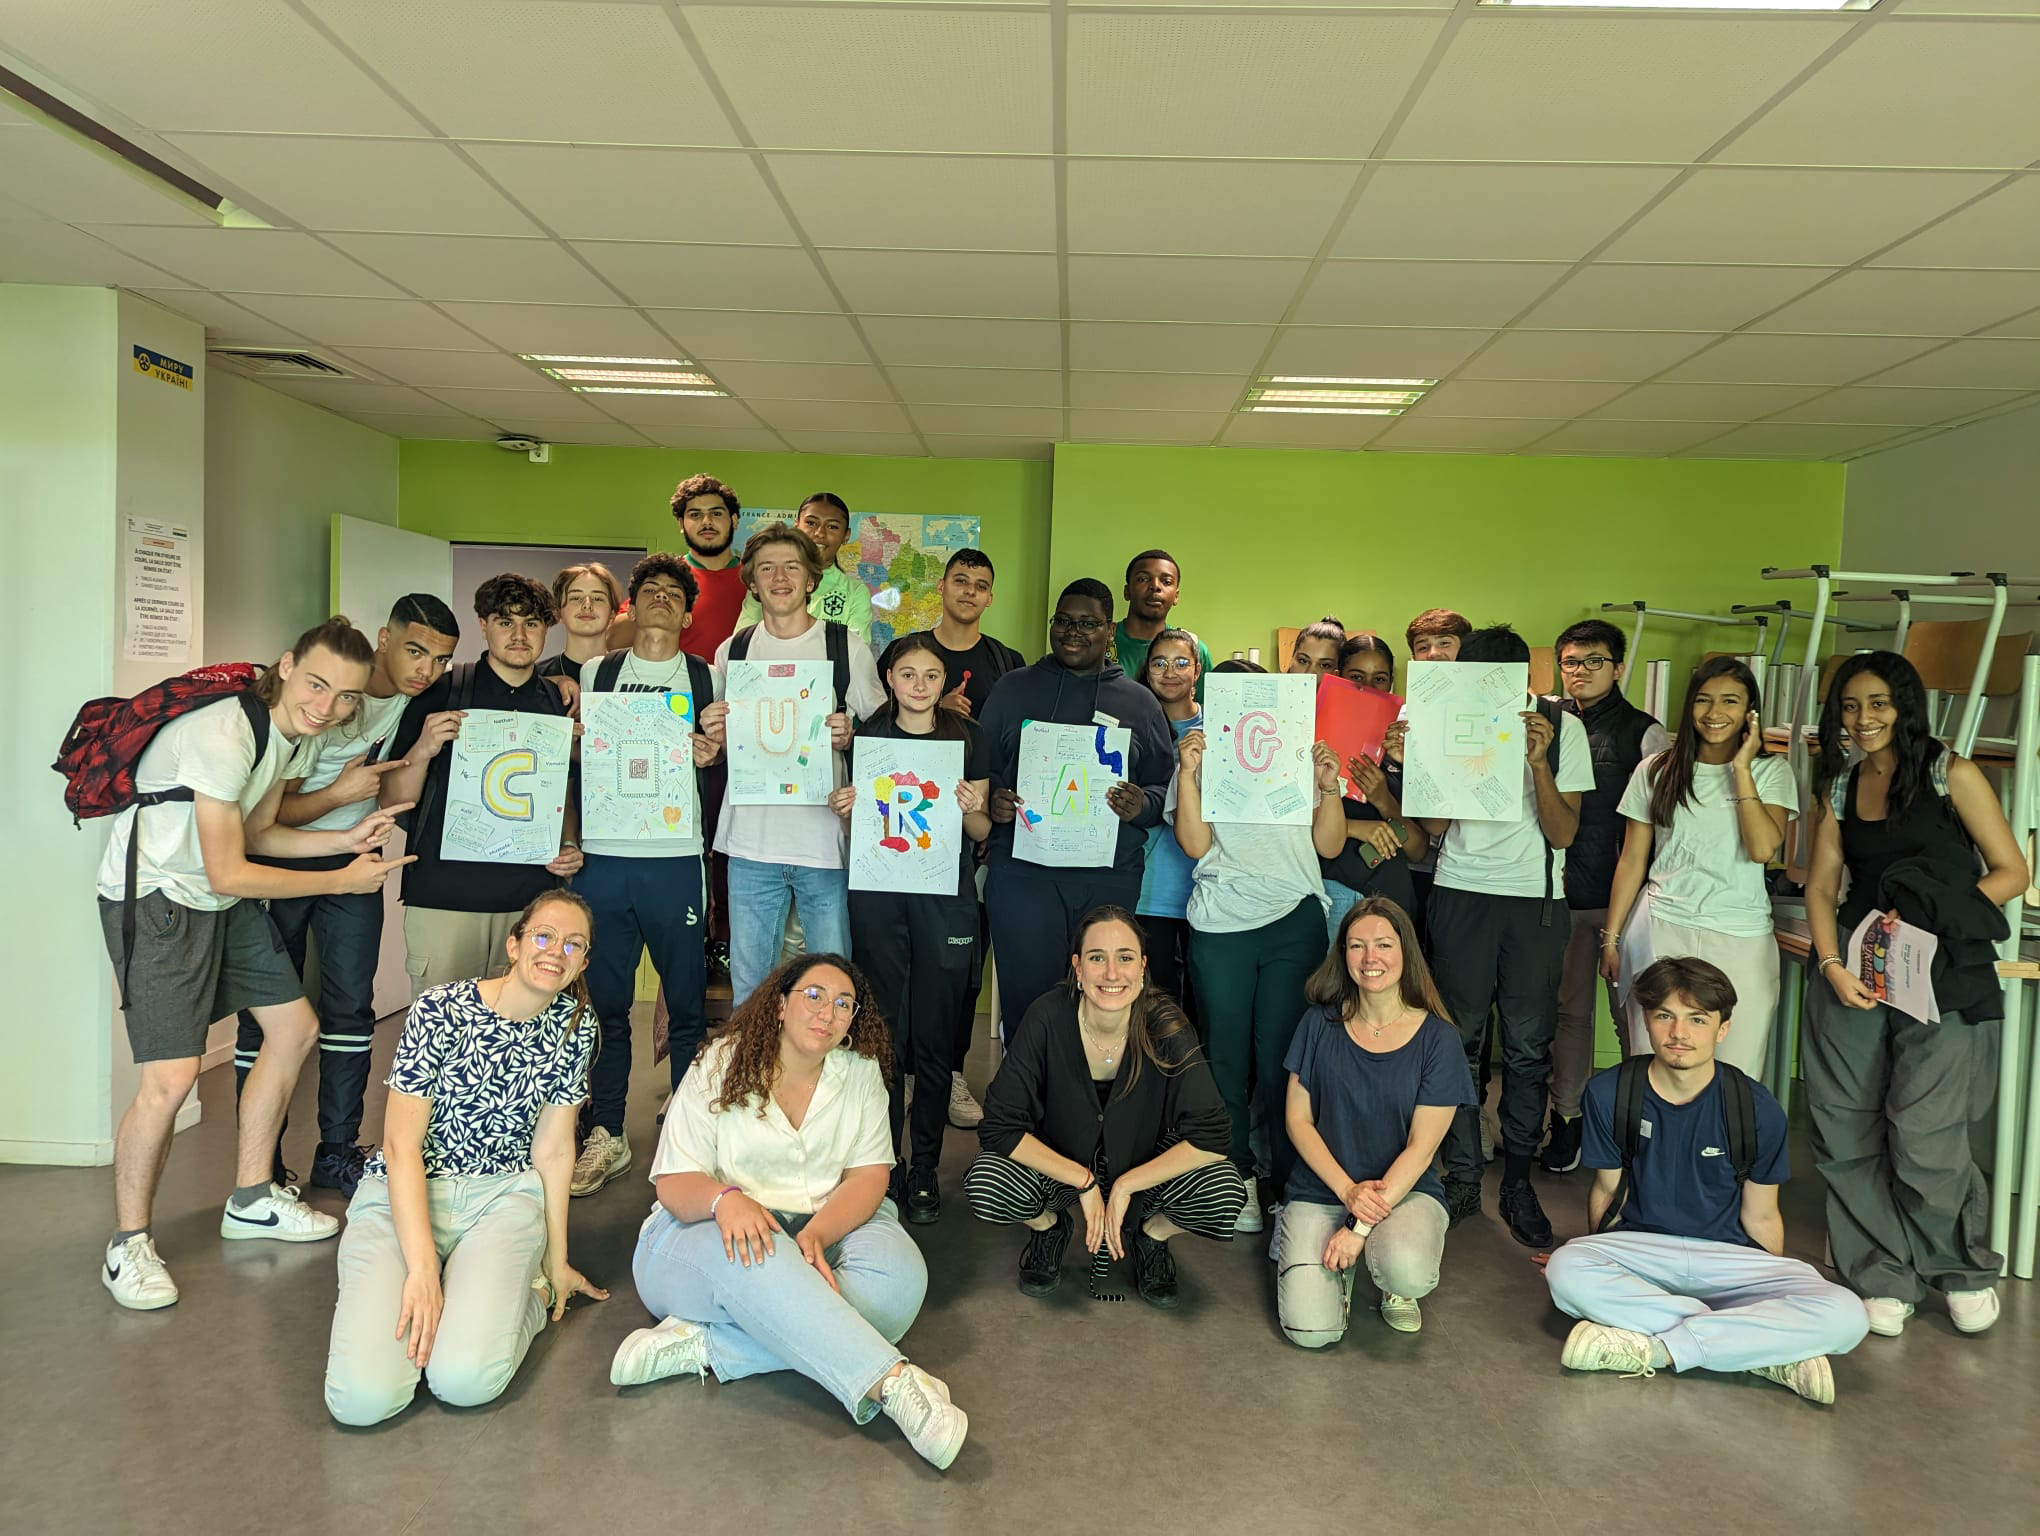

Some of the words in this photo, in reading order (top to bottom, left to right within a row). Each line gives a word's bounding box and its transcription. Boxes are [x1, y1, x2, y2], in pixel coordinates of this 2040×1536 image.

[155, 368, 188, 389] УКРАЇНІ
[160, 358, 184, 374] МИРУ
[742, 511, 771, 519] FRANCE
[756, 697, 800, 756] U
[1234, 711, 1283, 773] G
[1443, 700, 1487, 757] E
[481, 748, 538, 822] C
[888, 785, 925, 839] R
[1051, 763, 1089, 816] A
